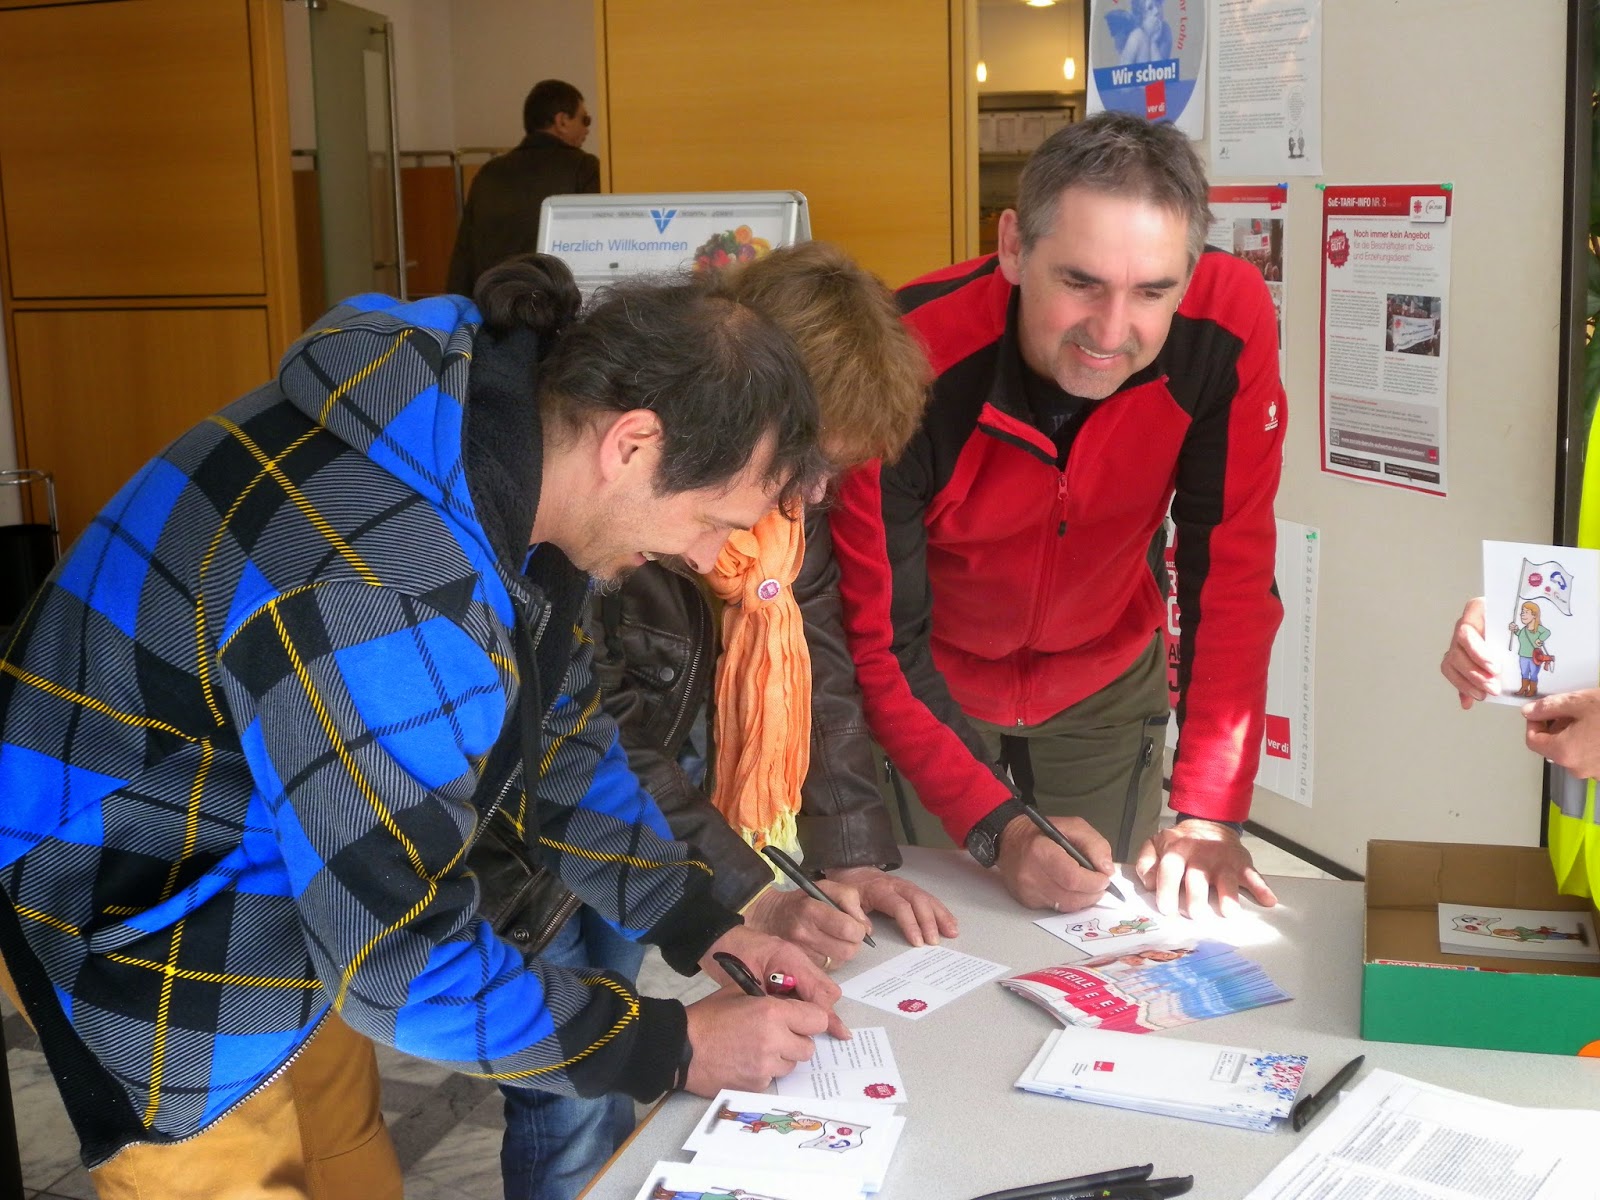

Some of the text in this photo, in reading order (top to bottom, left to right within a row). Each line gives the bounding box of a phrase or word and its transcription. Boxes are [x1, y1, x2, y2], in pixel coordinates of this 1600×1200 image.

[1177, 16, 1188, 50] Lohn
[1112, 62, 1176, 85] Wir schon!
[1382, 198, 1387, 207] 3
[1354, 230, 1430, 241] Noch immer kein Angebot
[551, 238, 688, 253] Herzlich Willkommen
